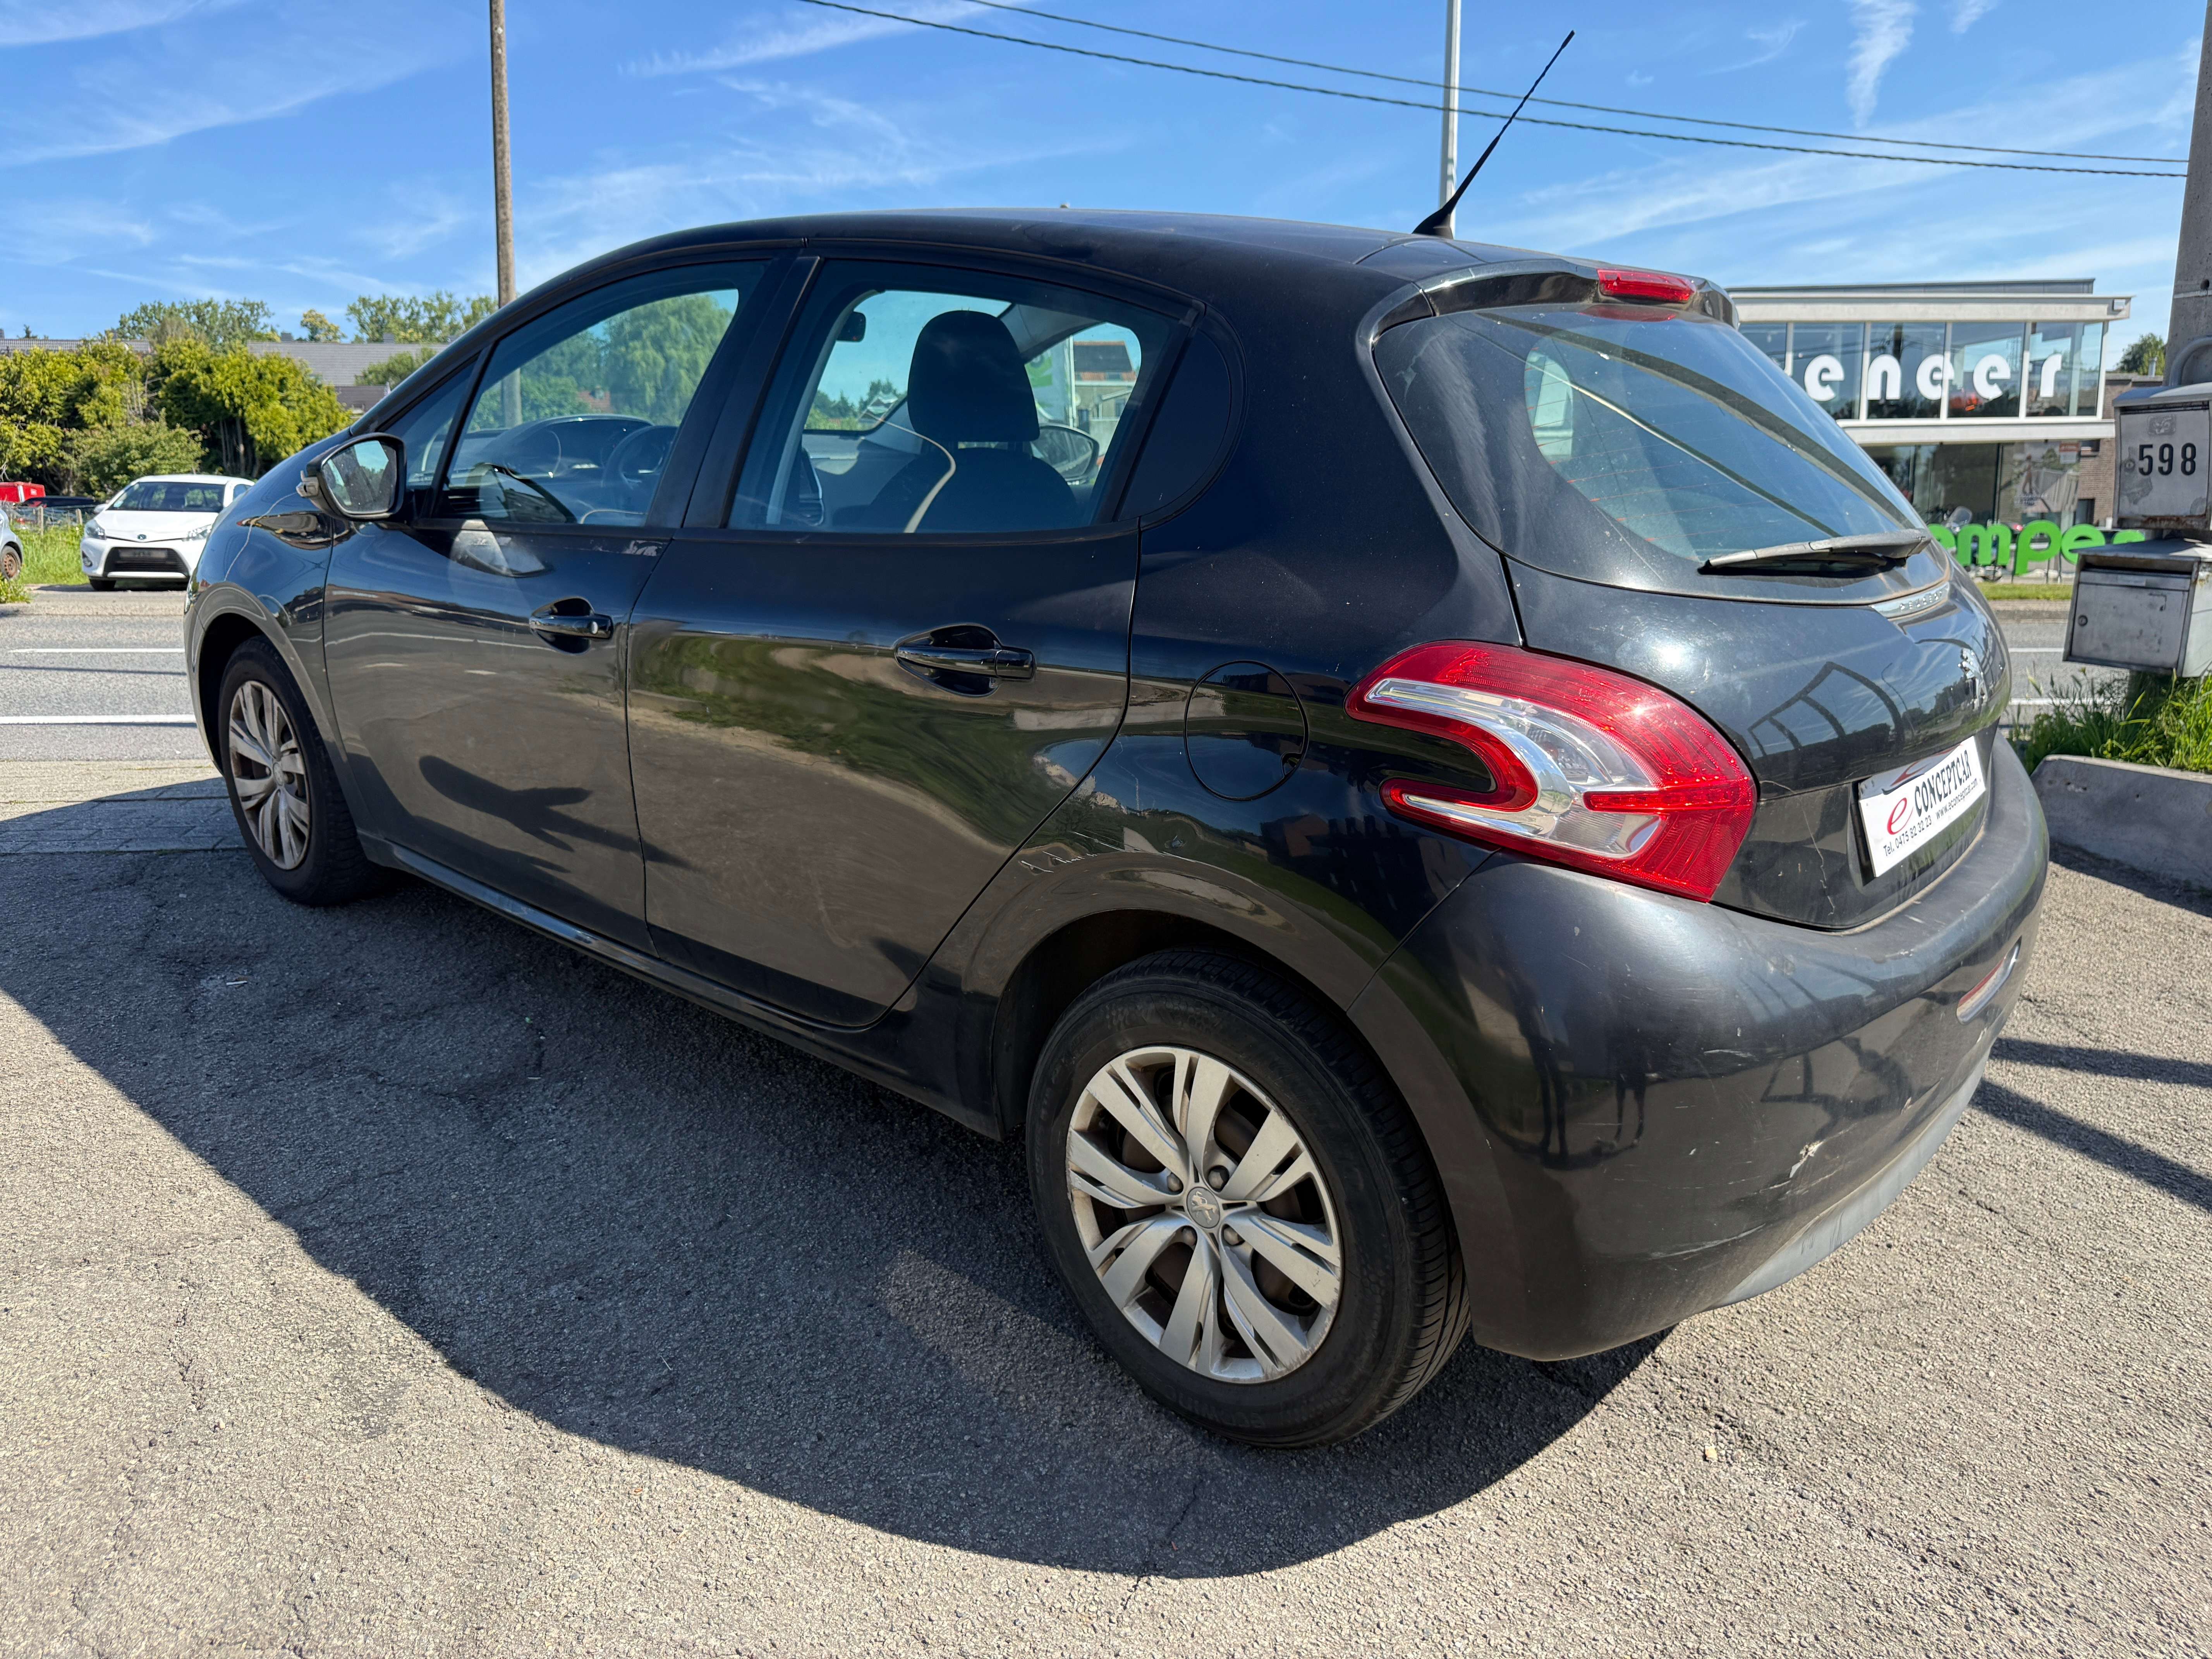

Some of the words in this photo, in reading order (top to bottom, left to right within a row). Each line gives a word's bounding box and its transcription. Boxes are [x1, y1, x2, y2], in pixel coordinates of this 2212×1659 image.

[2138, 443, 2196, 476] 598
[1927, 520, 2145, 575] mpe
[1887, 797, 1913, 835] e
[1914, 750, 1972, 817] CONCEPTCAR
[1883, 842, 1894, 857] Tel.
[1895, 831, 1909, 848] 0475
[1910, 826, 1917, 838] 82
[1918, 820, 1925, 833] 32
[1925, 815, 1932, 828] 23
